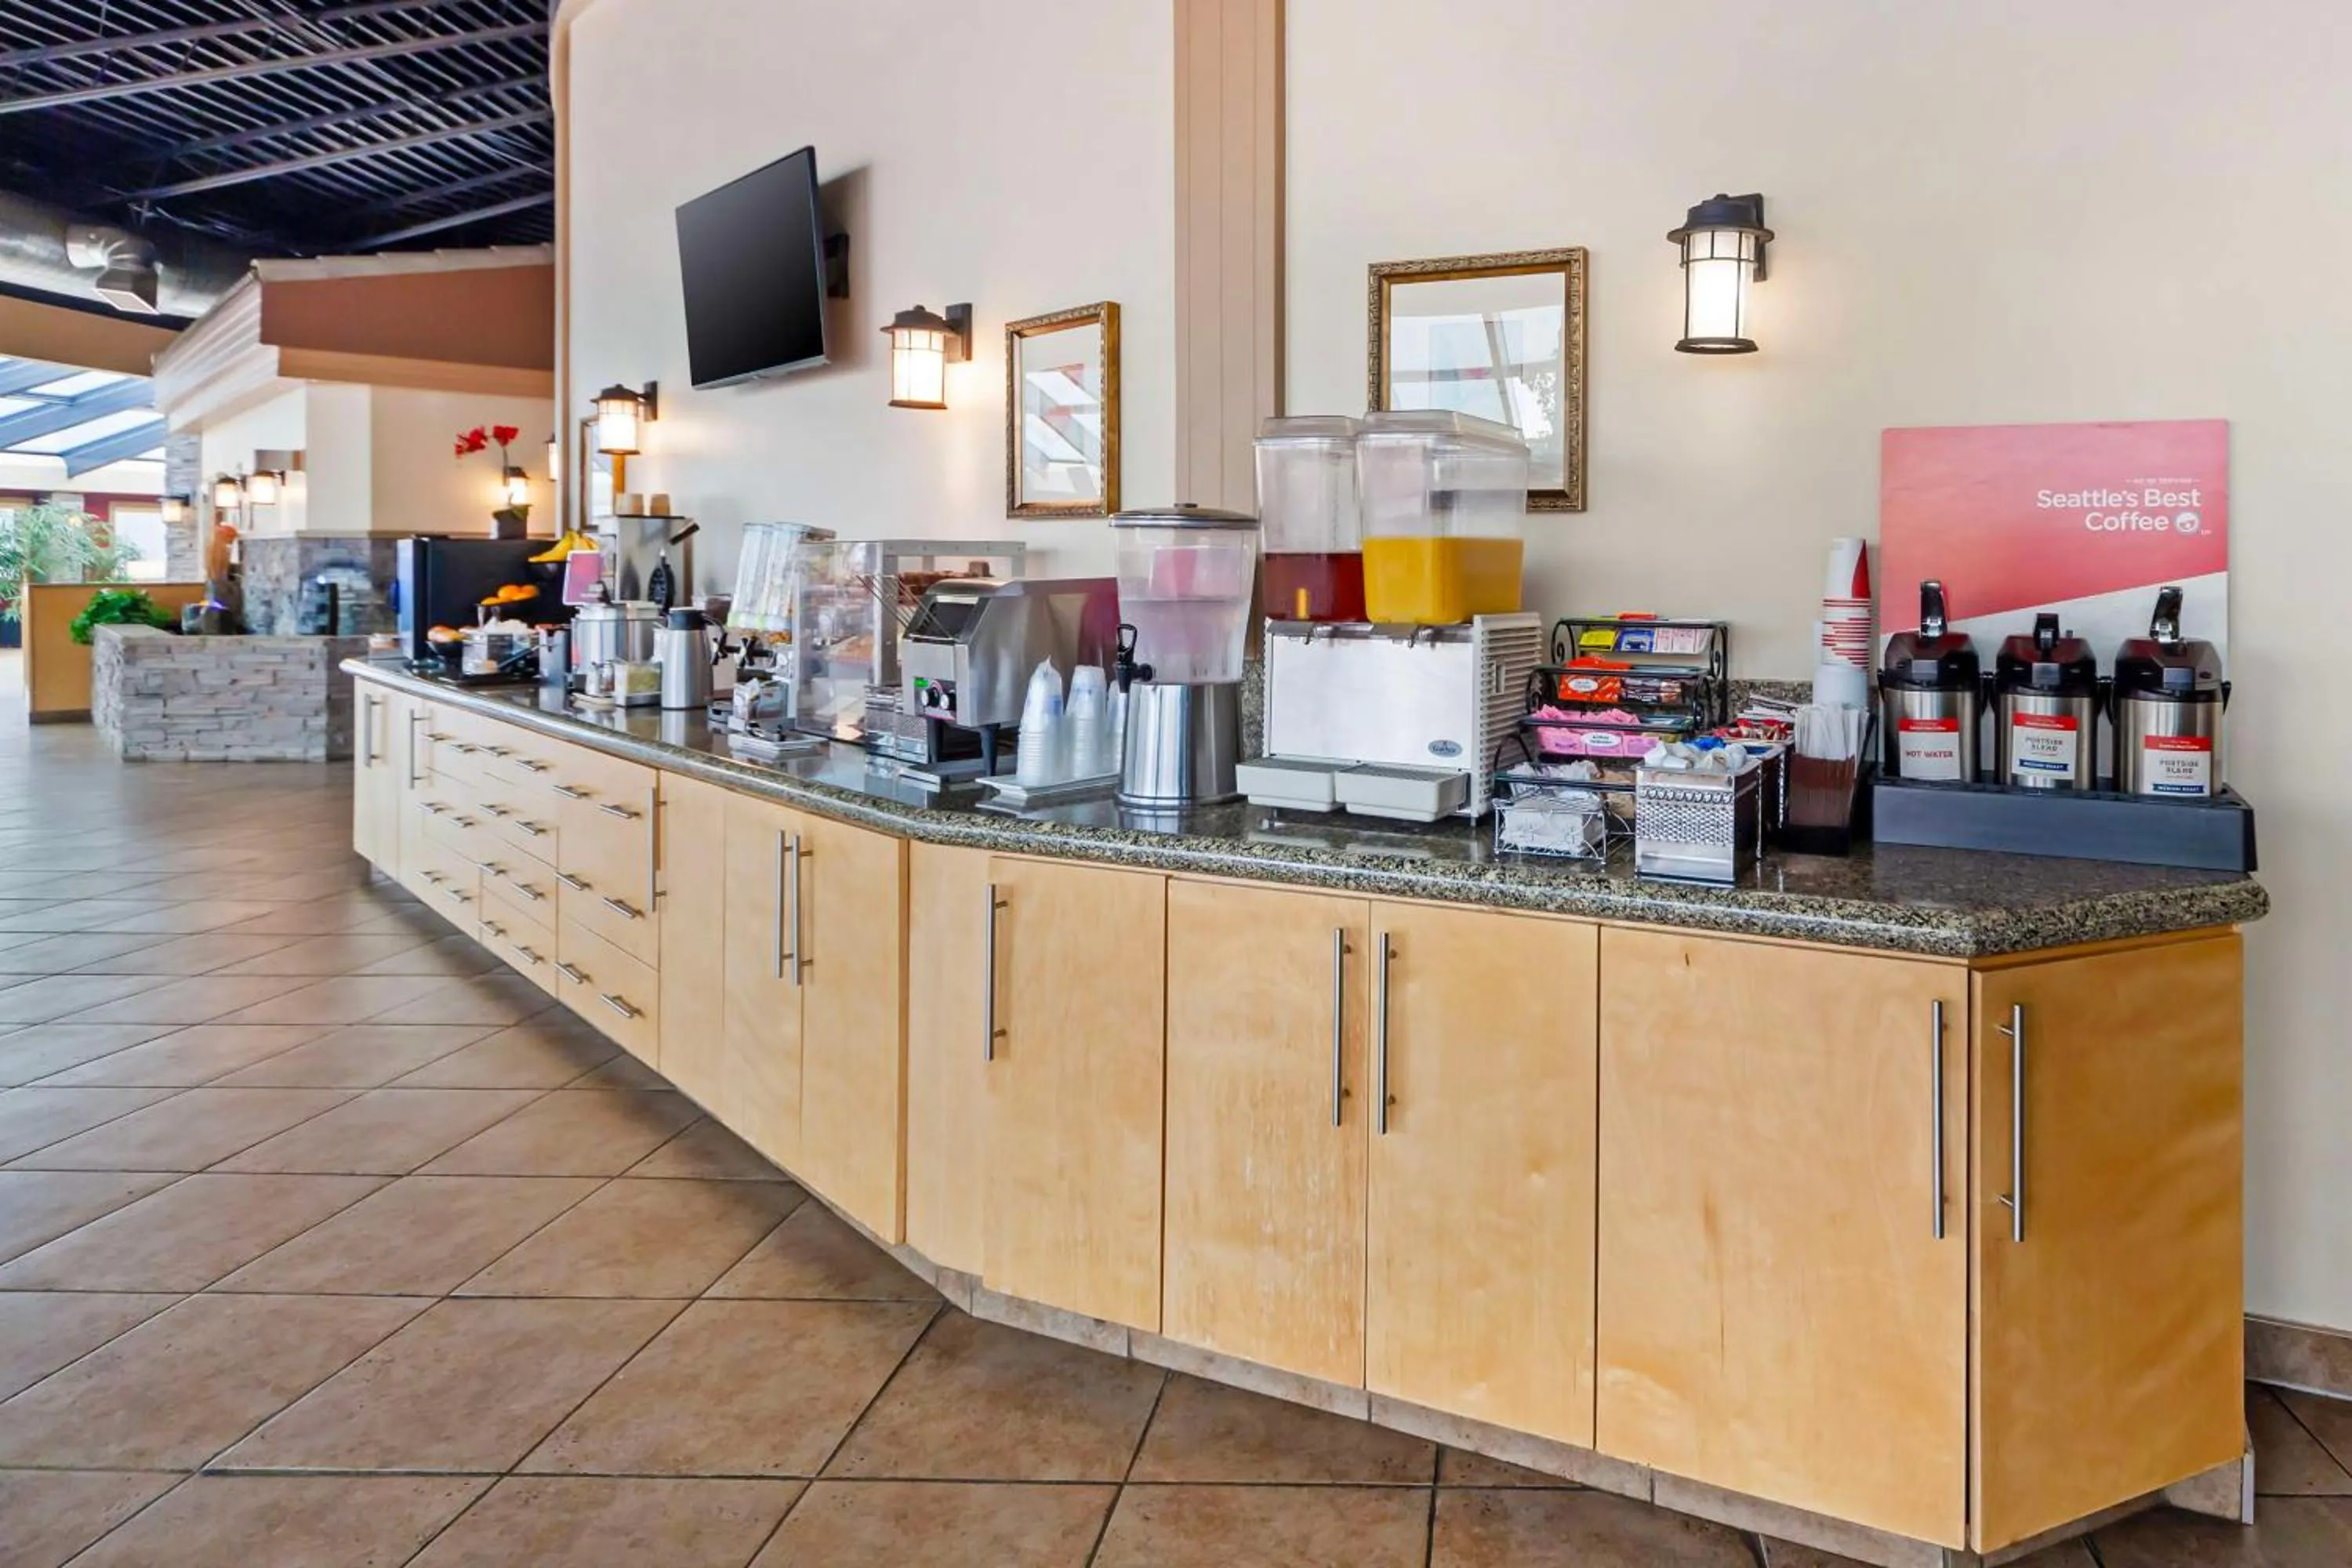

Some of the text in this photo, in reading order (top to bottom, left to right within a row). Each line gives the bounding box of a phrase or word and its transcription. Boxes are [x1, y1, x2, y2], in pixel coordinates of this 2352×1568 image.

[2037, 488, 2201, 508] Seattle's Best
[2085, 512, 2169, 532] Coffee
